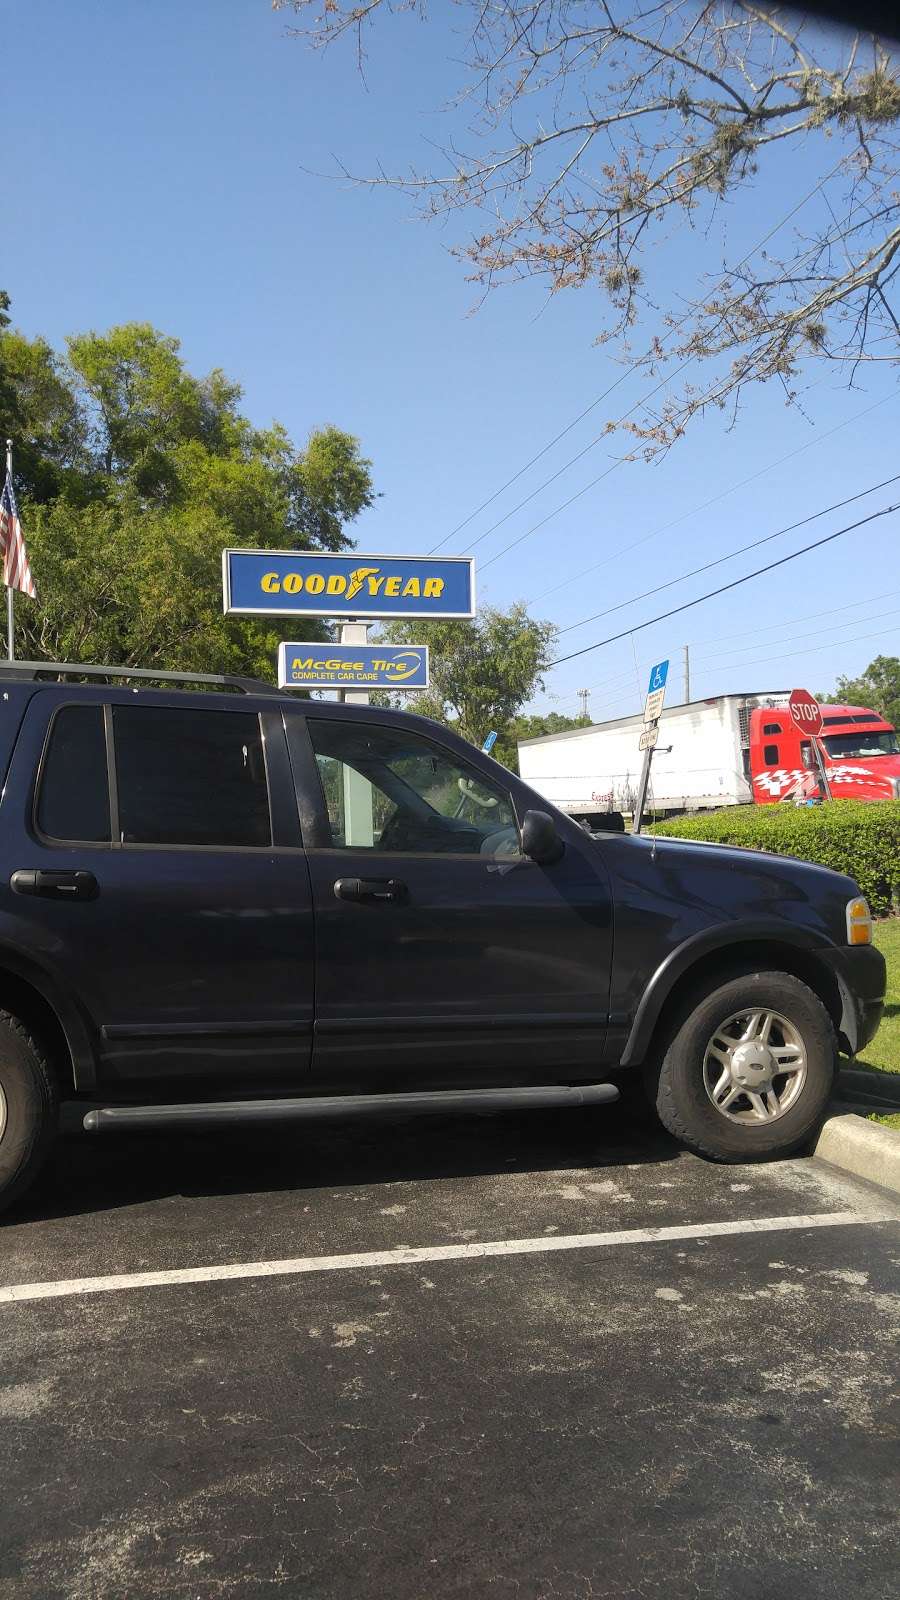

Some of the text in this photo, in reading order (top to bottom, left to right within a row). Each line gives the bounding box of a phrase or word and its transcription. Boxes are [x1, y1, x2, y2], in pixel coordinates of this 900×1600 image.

[292, 658, 407, 672] McGee Tire
[292, 671, 378, 681] COMPLETE CAR CARE
[791, 703, 819, 721] STOP
